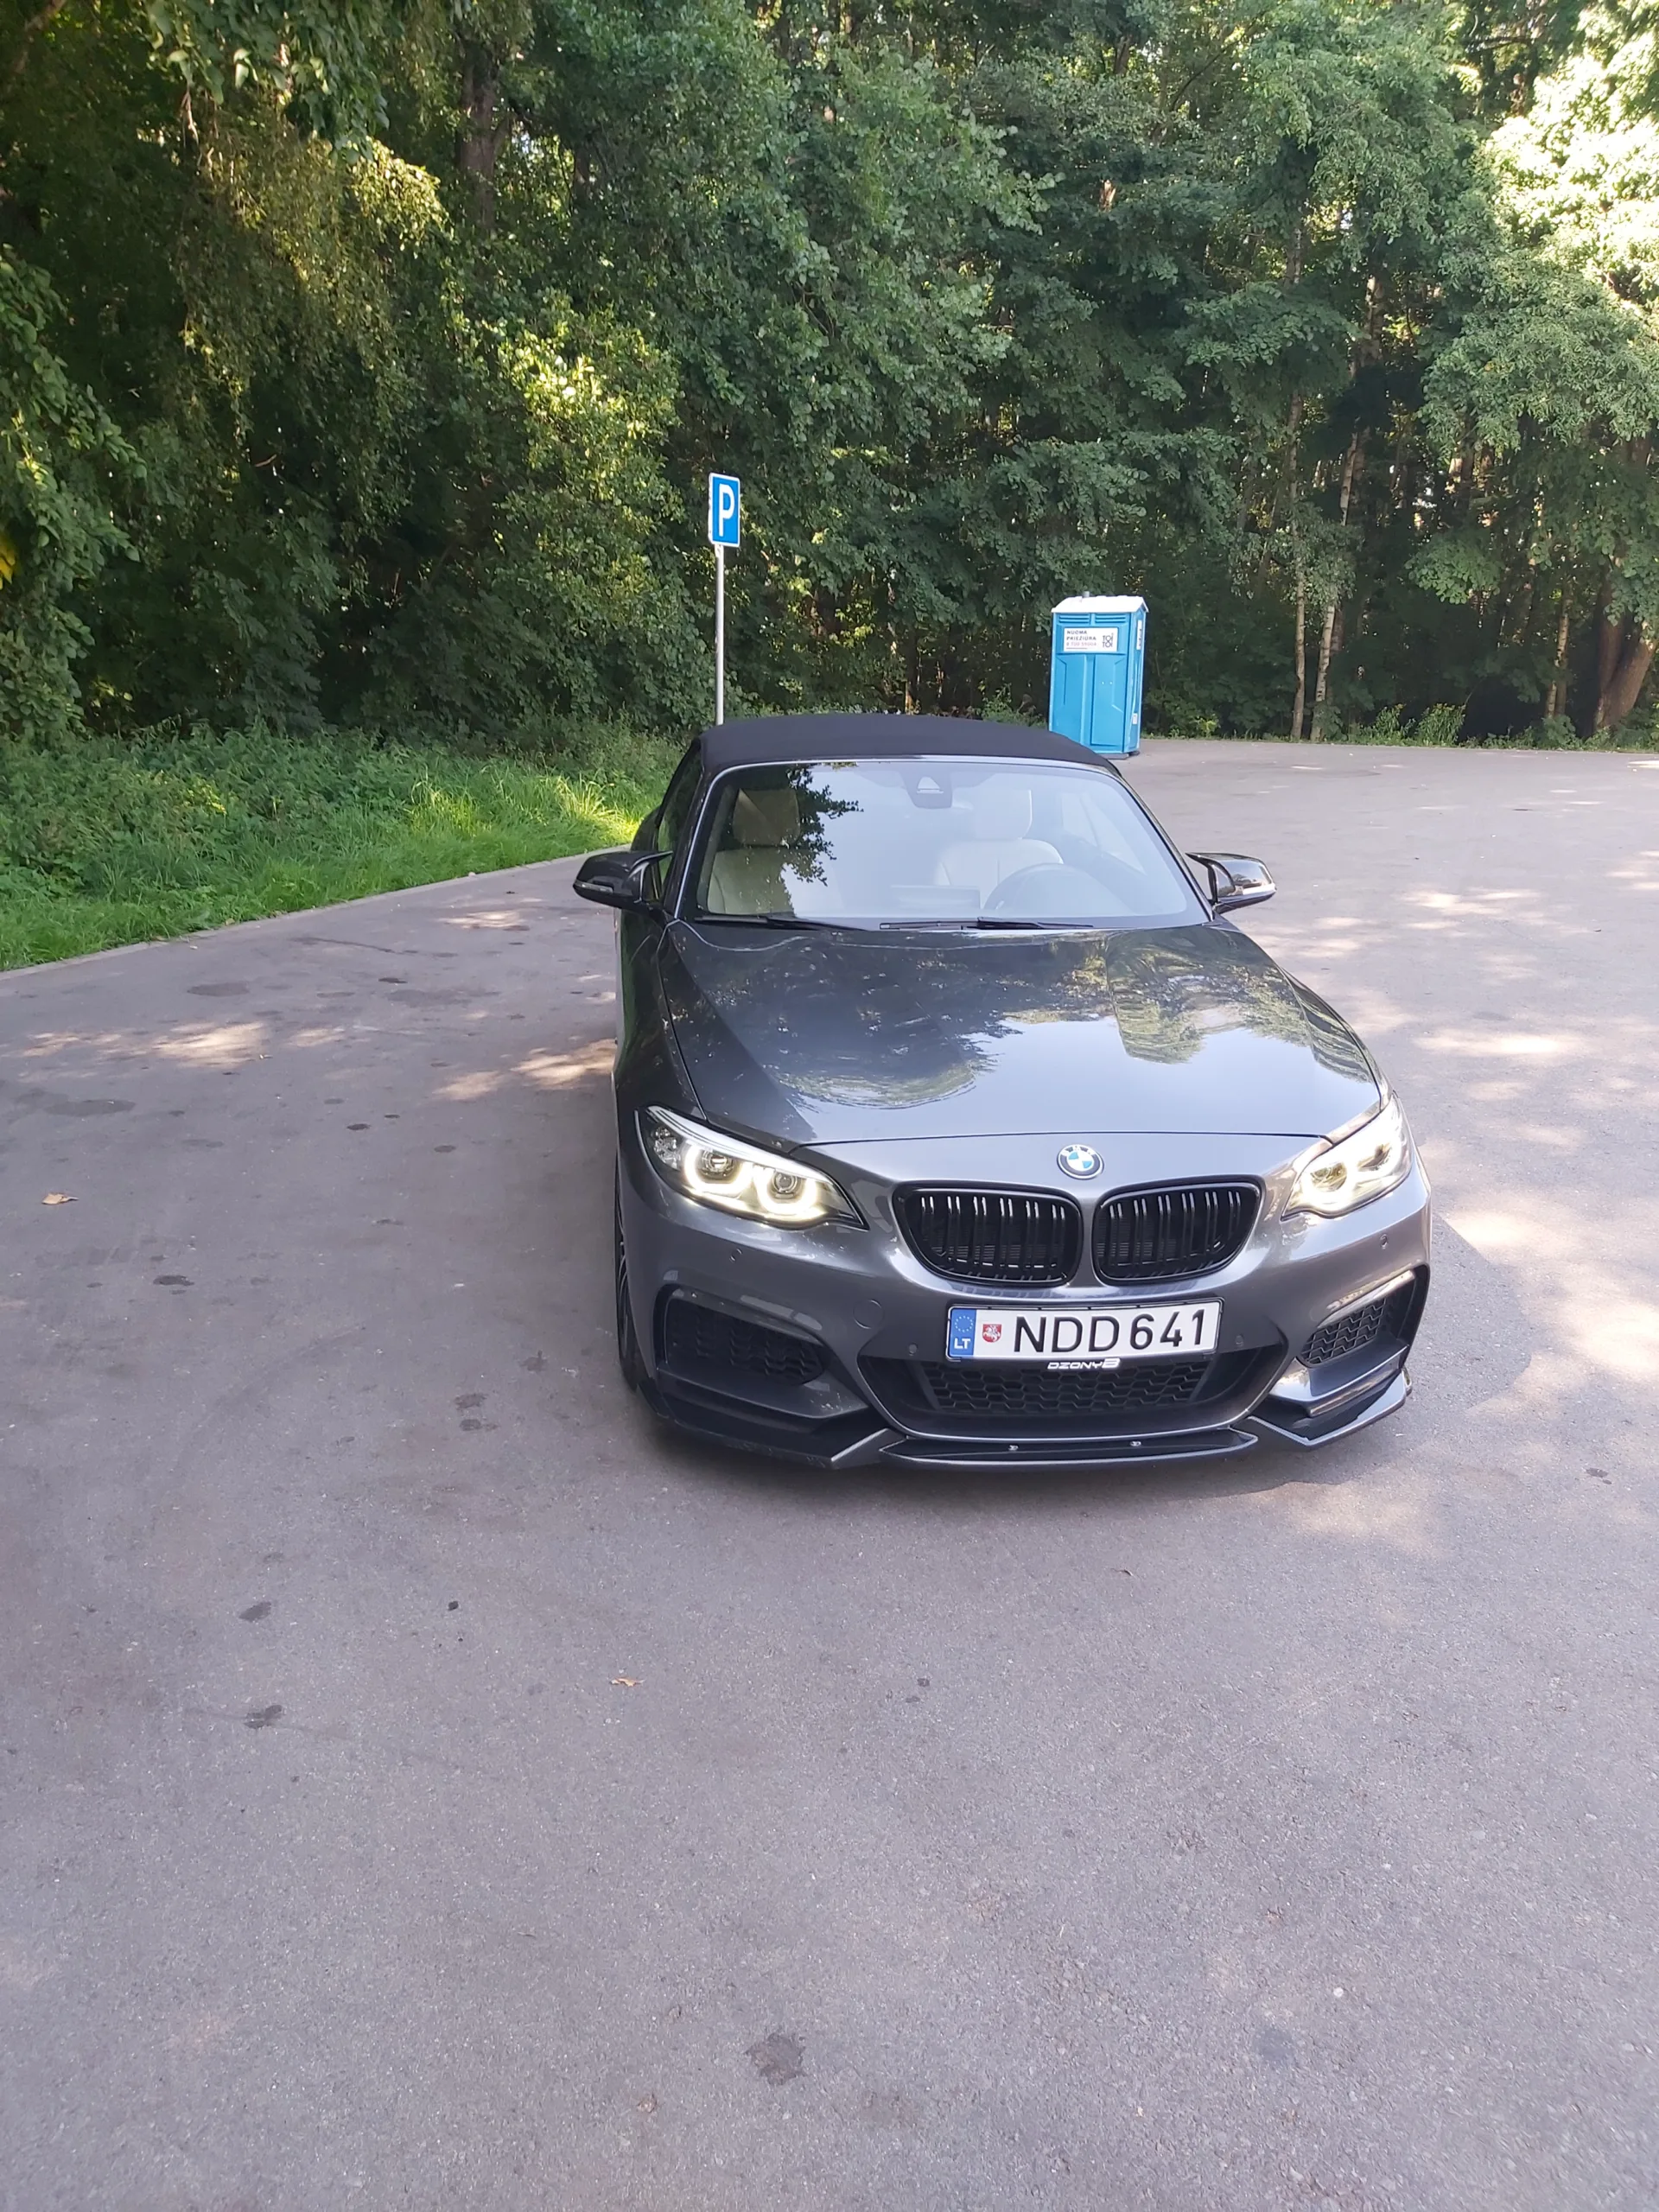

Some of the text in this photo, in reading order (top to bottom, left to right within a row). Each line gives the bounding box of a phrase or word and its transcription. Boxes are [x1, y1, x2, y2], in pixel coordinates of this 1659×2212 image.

[719, 483, 734, 537] P
[954, 1338, 971, 1350] LT
[1014, 1308, 1206, 1353] NDD 641
